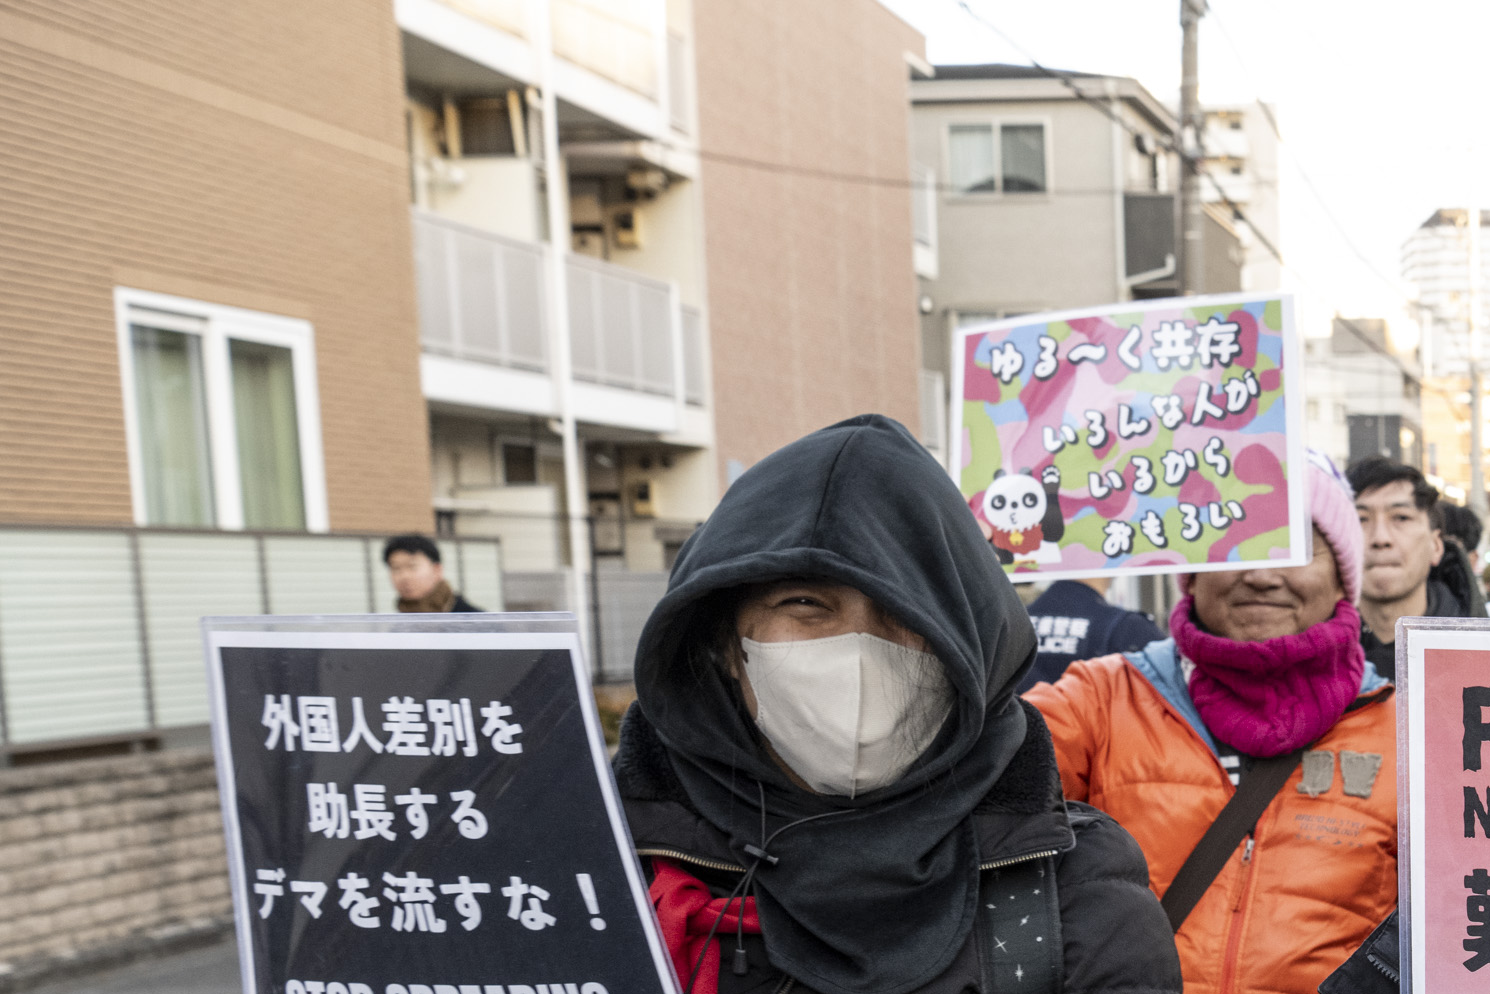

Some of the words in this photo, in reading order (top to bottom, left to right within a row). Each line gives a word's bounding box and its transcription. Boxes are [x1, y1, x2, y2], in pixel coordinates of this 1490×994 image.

[1042, 370, 1260, 452] いろんな人が
[1088, 437, 1230, 499] いるから
[1102, 500, 1244, 557] おもろい
[261, 695, 523, 757] 外国人差別を
[307, 782, 489, 840] 助長する
[253, 868, 607, 933] デマを流すな！
